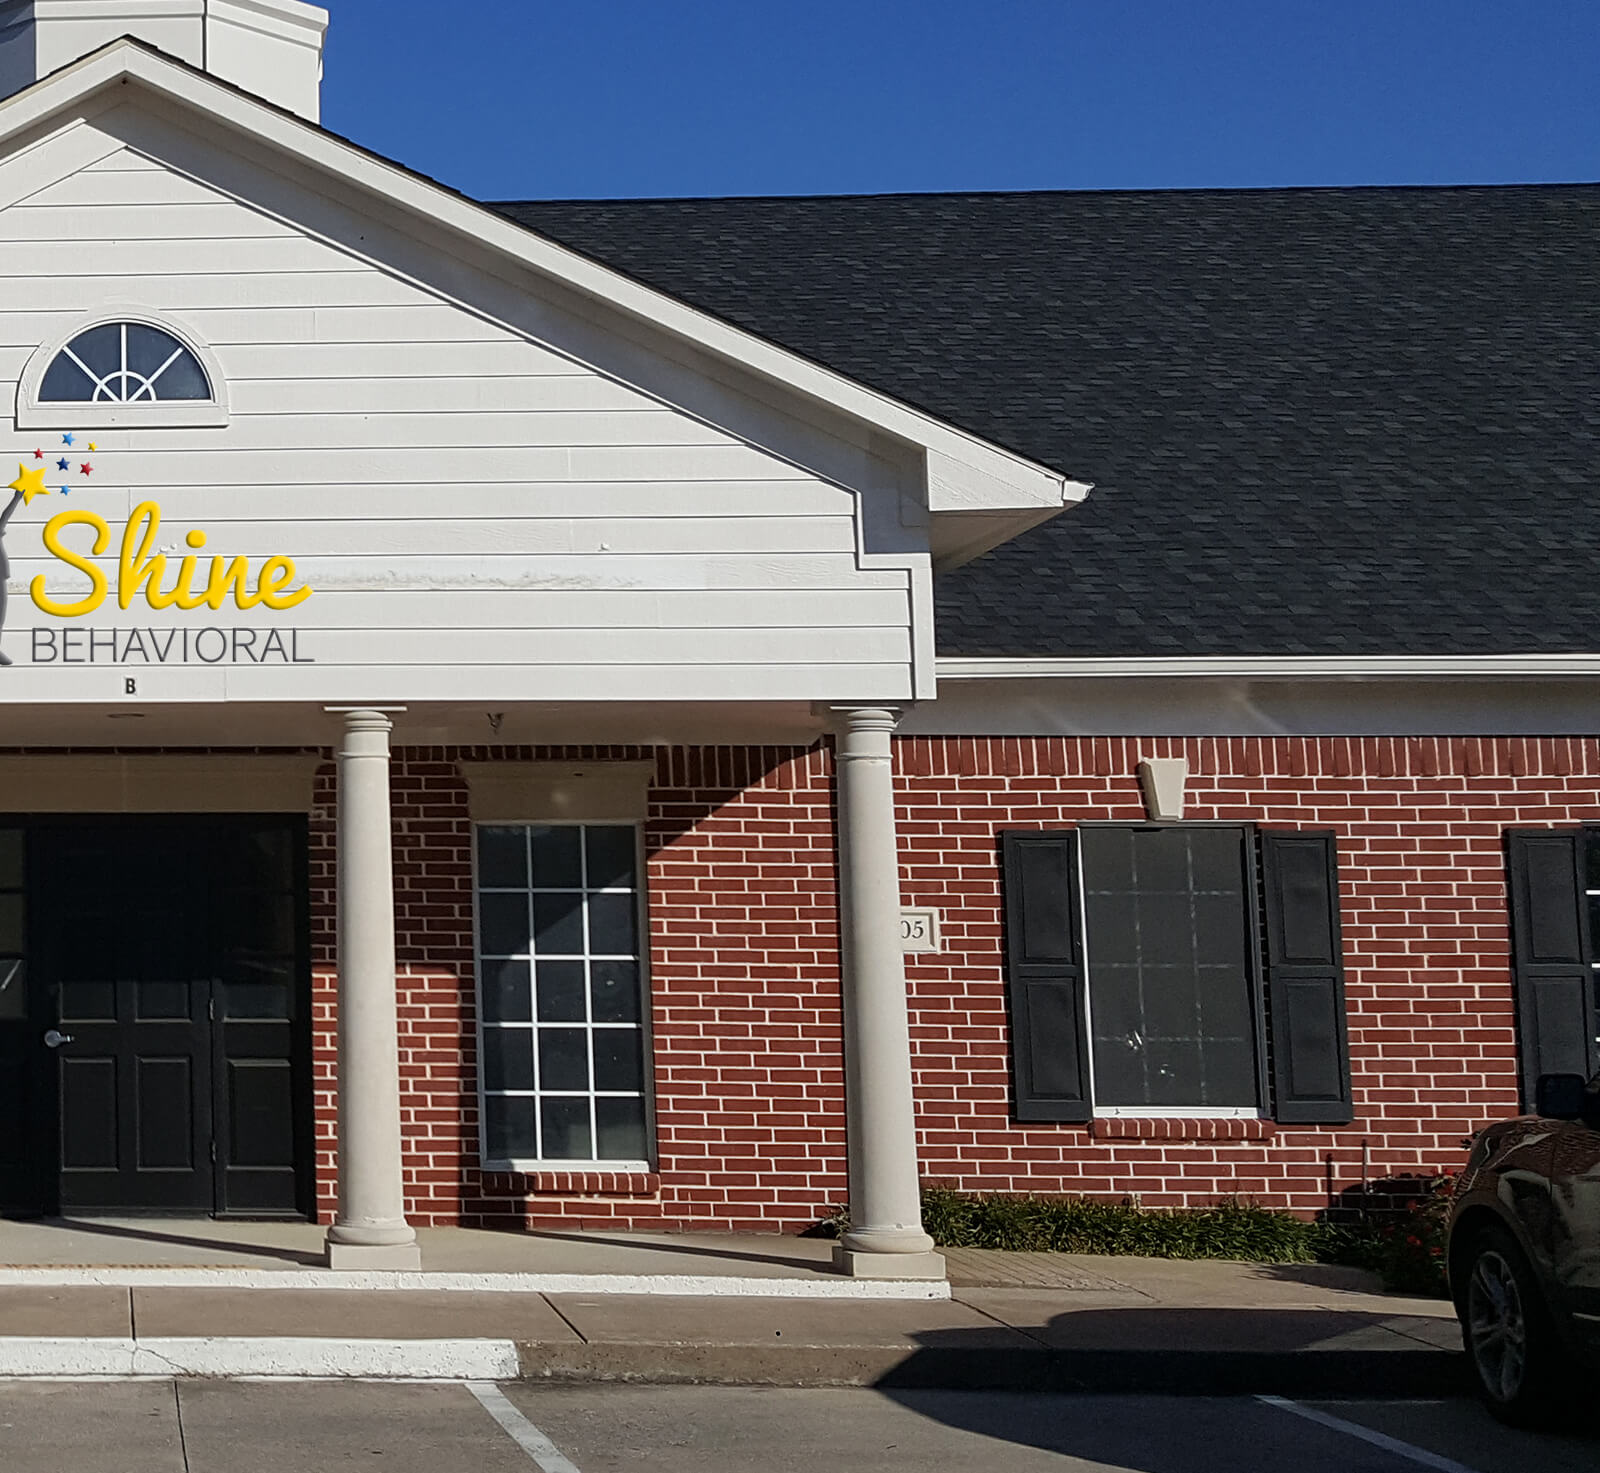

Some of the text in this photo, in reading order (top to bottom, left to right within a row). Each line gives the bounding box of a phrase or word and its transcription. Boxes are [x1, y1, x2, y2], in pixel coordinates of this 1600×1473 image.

[30, 500, 314, 617] Shine
[31, 627, 315, 663] BEHAVIORAL
[125, 678, 136, 694] B
